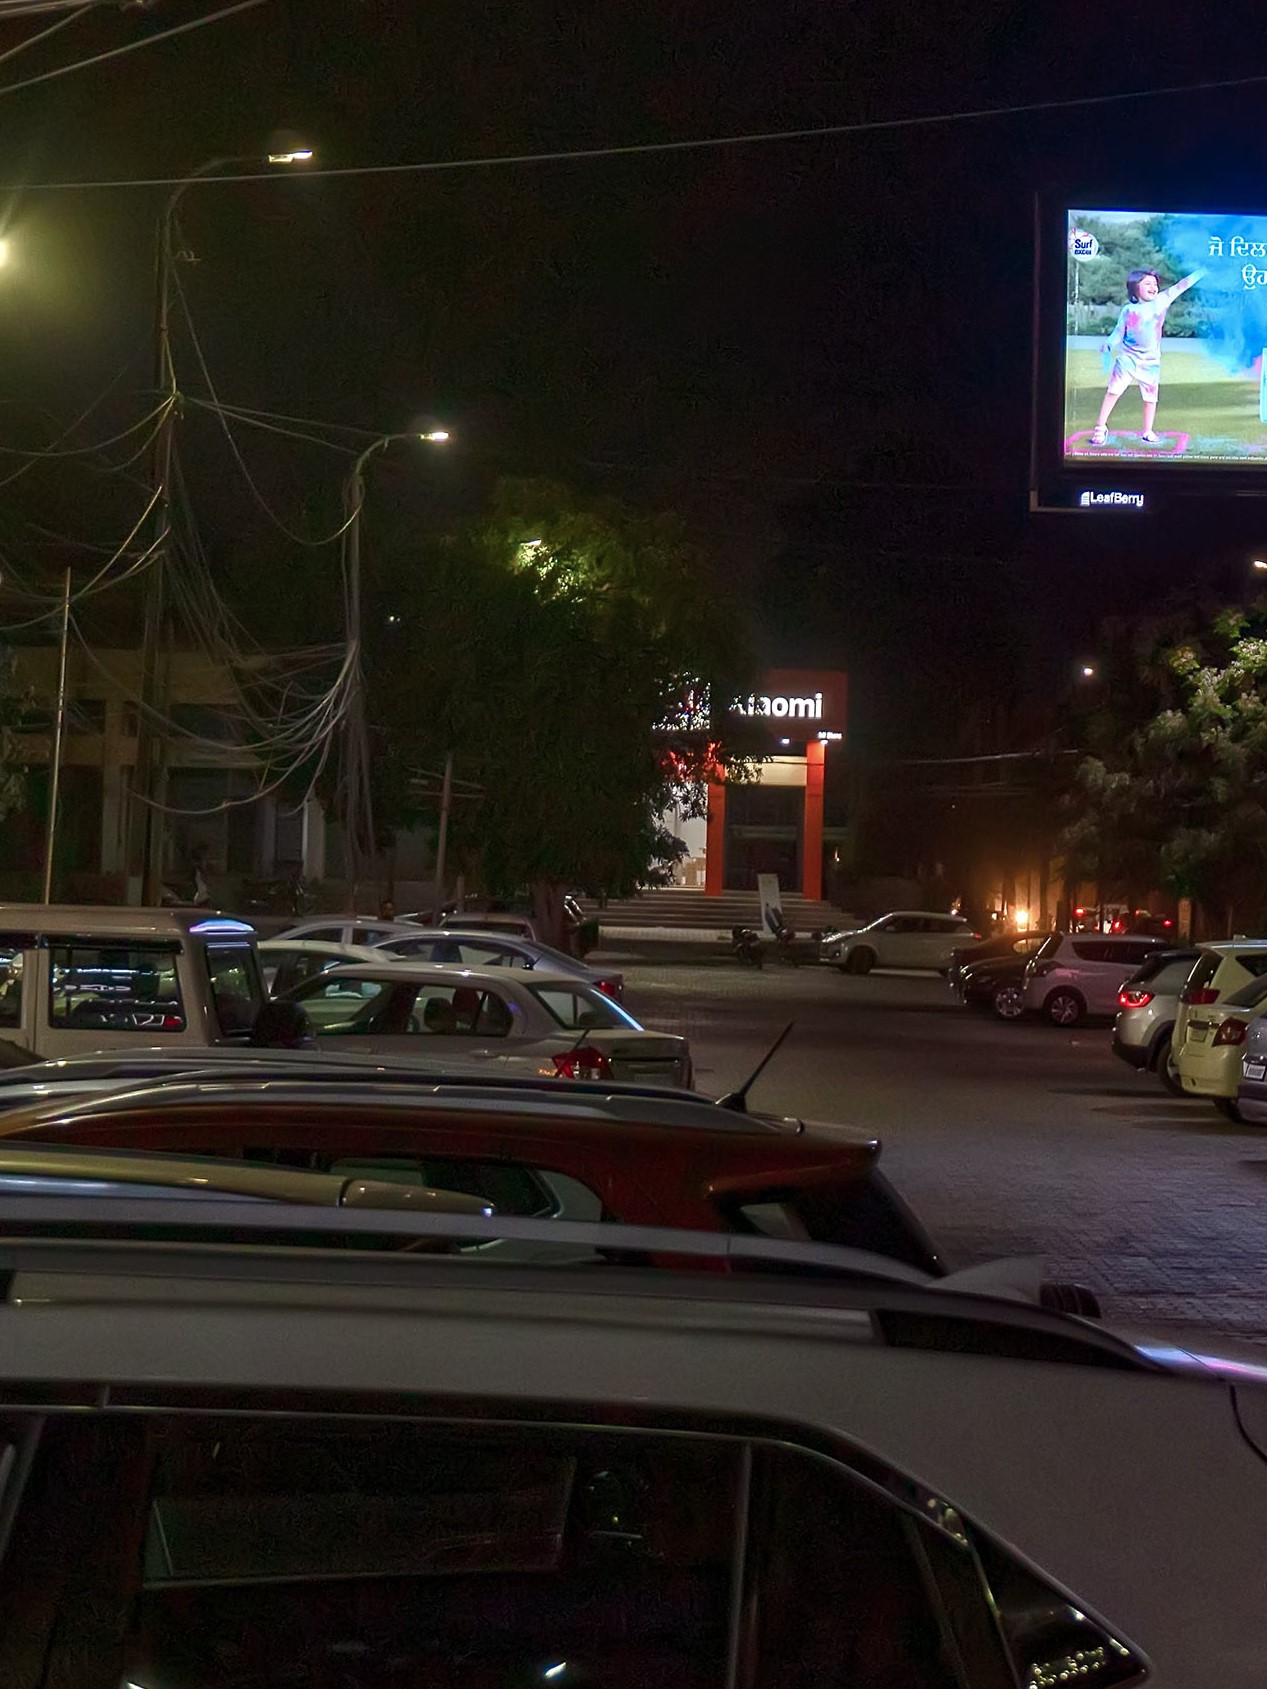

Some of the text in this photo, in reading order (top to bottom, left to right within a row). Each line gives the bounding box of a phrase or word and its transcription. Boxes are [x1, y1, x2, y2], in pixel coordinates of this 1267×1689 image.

[1075, 239, 1093, 249] Surf
[1208, 236, 1223, 256] ਜੋ
[1090, 491, 1144, 507] LeafBerry
